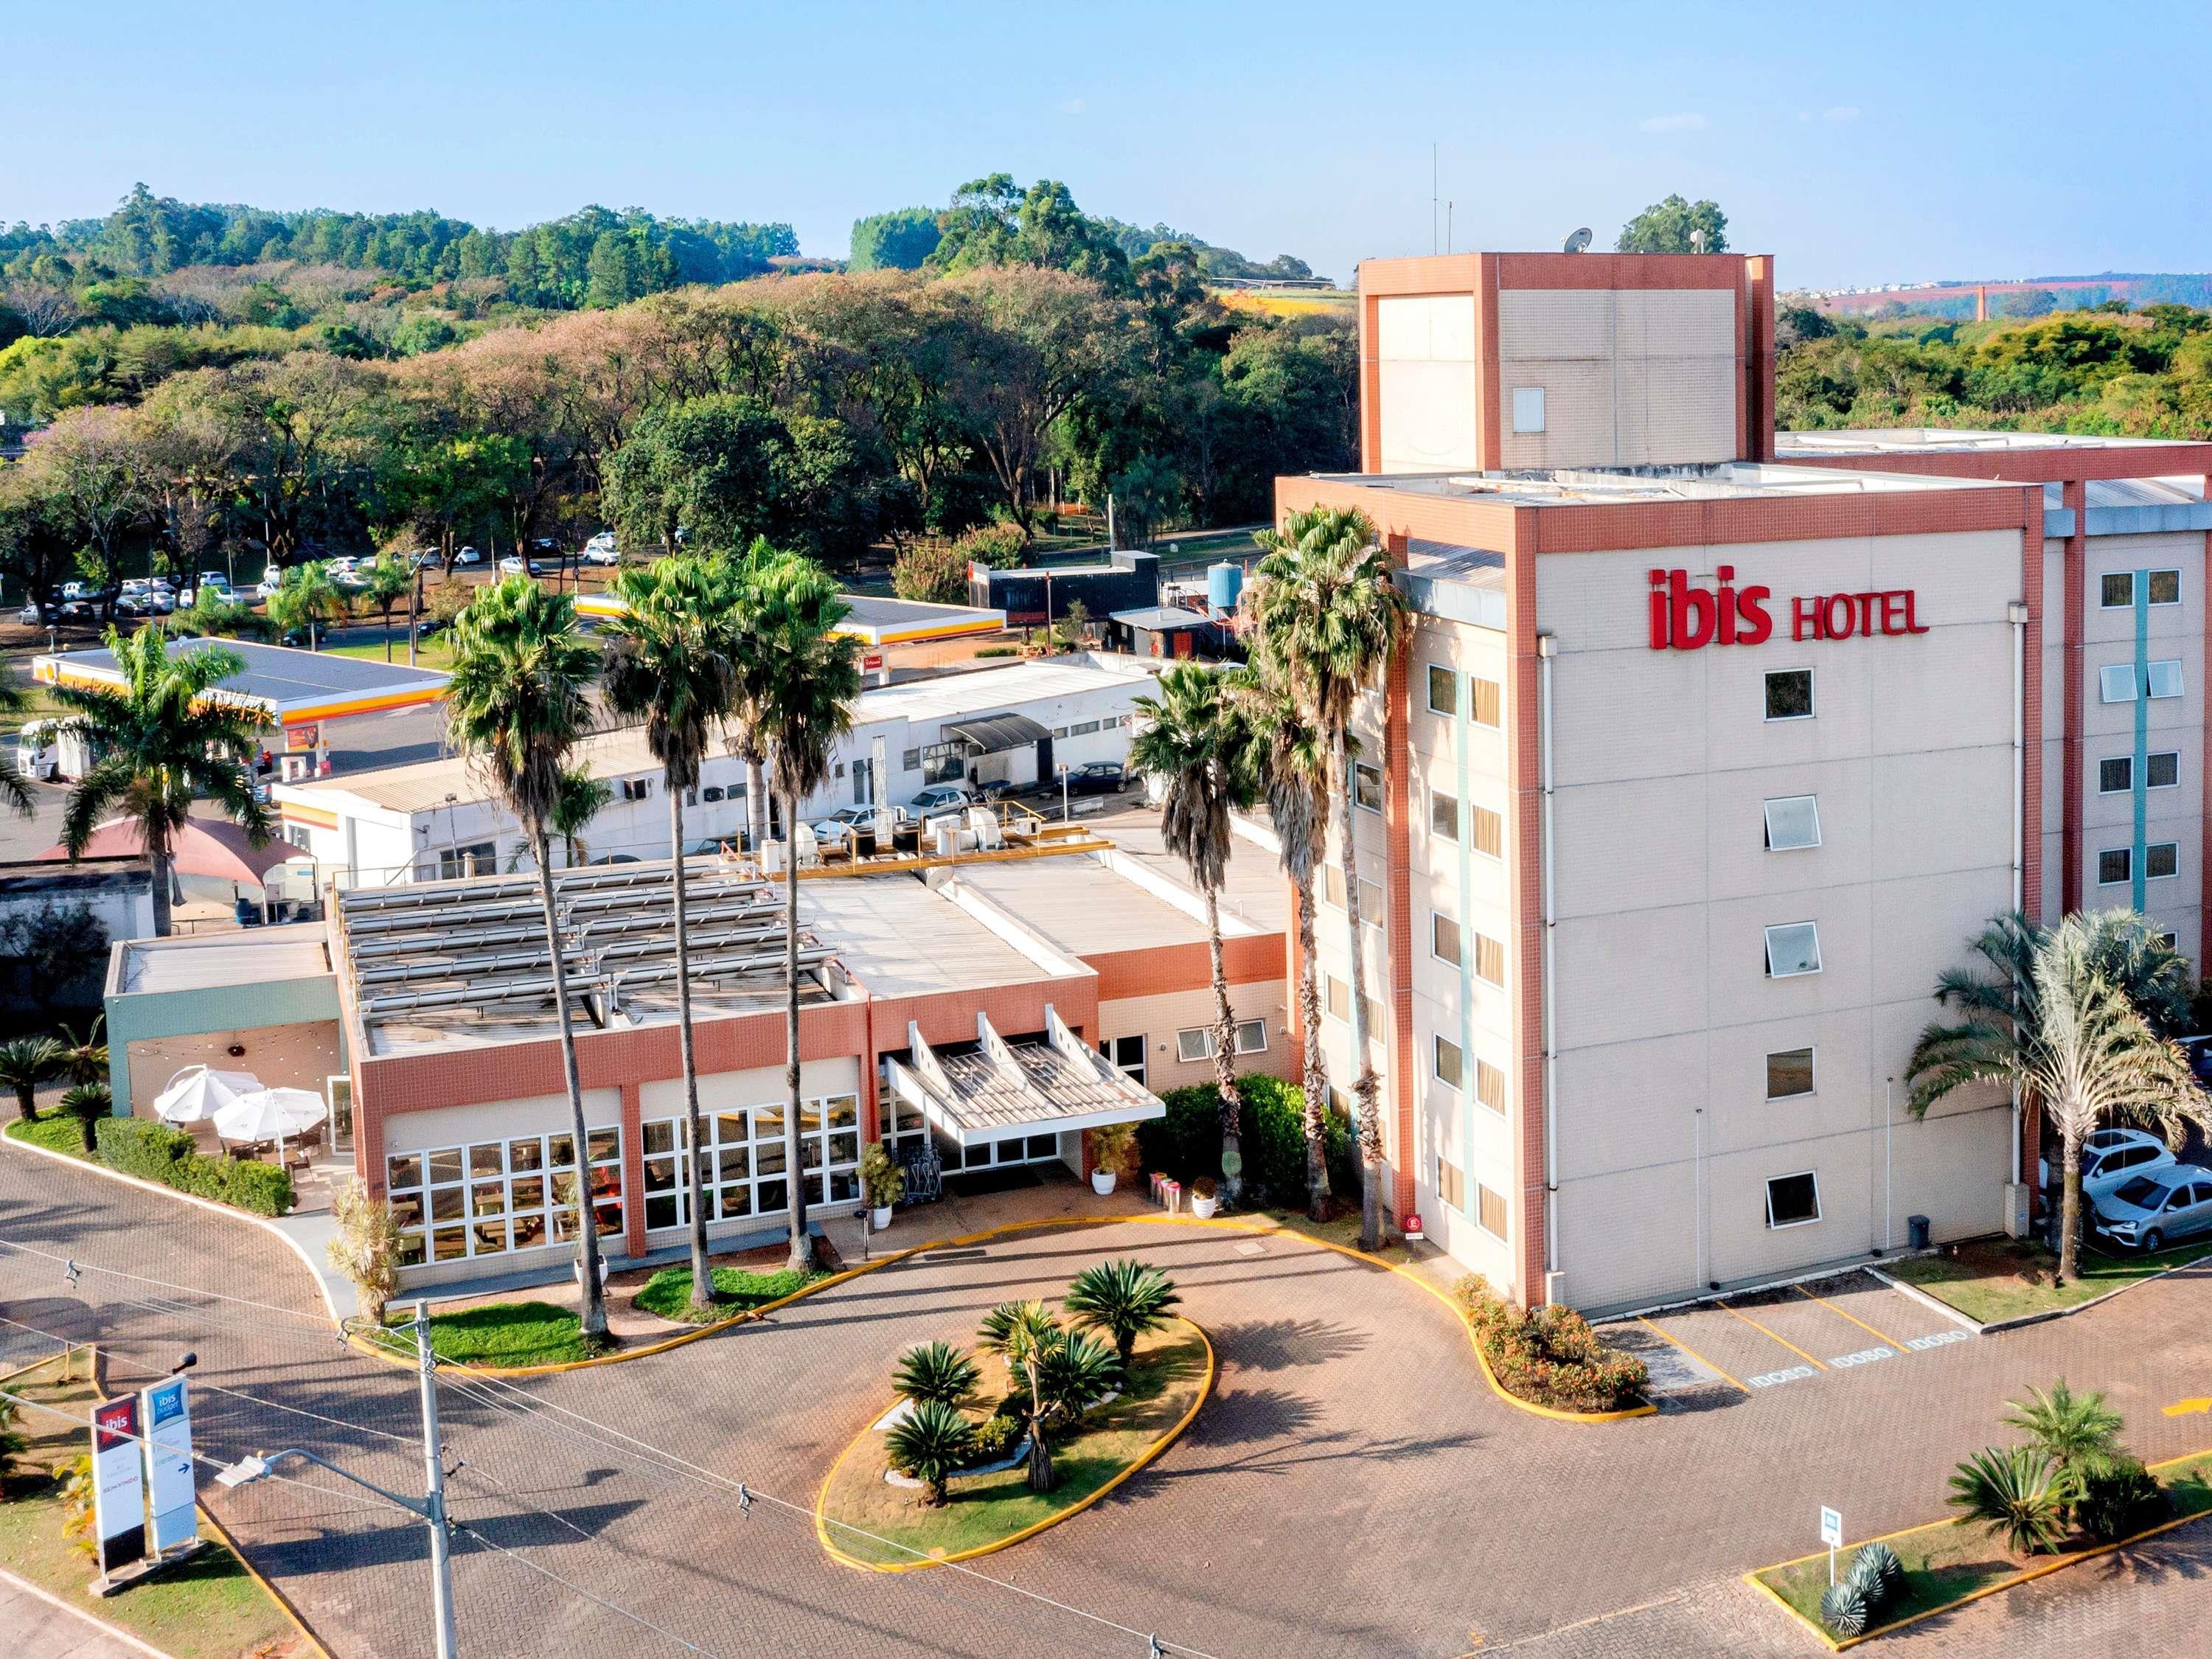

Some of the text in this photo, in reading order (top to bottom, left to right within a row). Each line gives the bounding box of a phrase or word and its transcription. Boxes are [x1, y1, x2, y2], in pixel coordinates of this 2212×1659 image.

[1649, 565, 1930, 650] ibis HOTEL
[1905, 1329, 1969, 1351] IDOSO
[1831, 1346, 1895, 1368] IDOSO
[1746, 1365, 1814, 1388] IDOSO
[157, 1401, 178, 1415] budget
[159, 1392, 176, 1407] ibis
[105, 1415, 128, 1430] ibis
